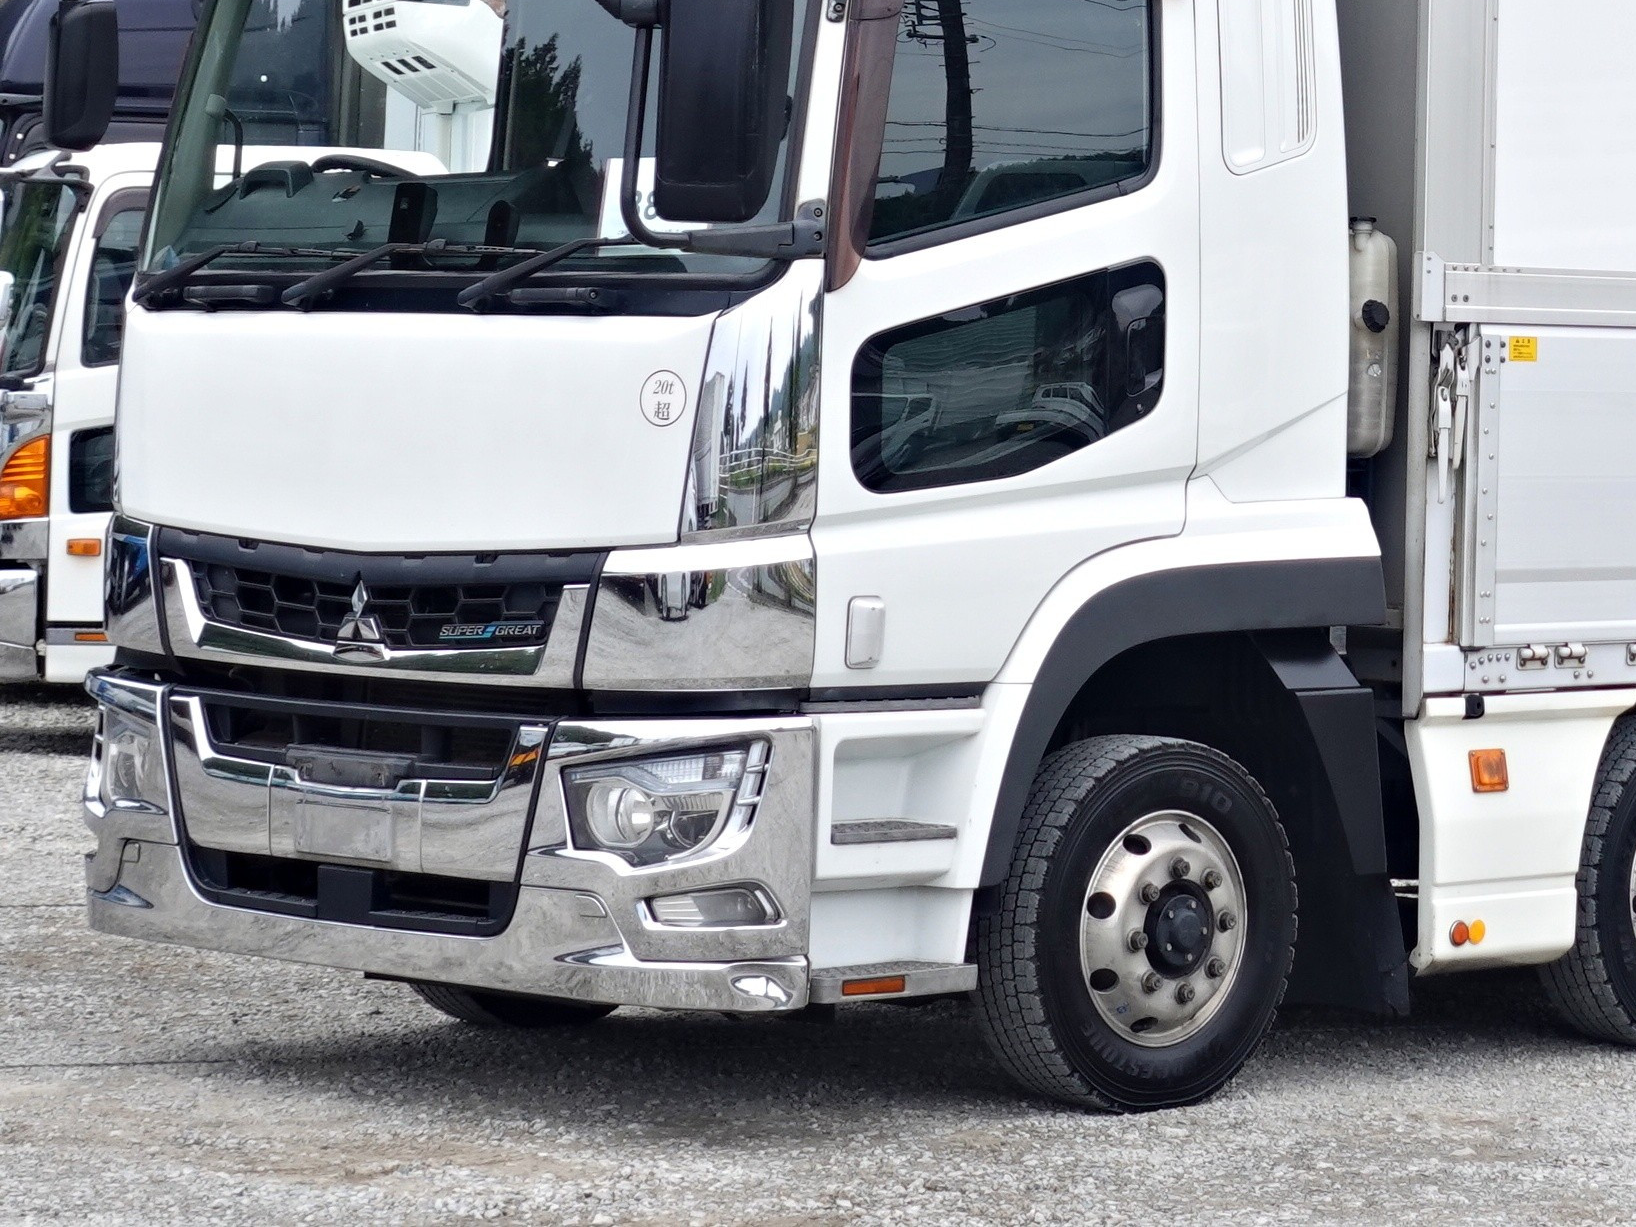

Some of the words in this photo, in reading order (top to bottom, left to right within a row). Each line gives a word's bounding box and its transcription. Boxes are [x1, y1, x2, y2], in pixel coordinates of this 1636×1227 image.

[653, 379, 675, 395] 20t
[653, 401, 671, 421] 超
[440, 625, 485, 636] SUPER
[495, 625, 541, 636] GREAT
